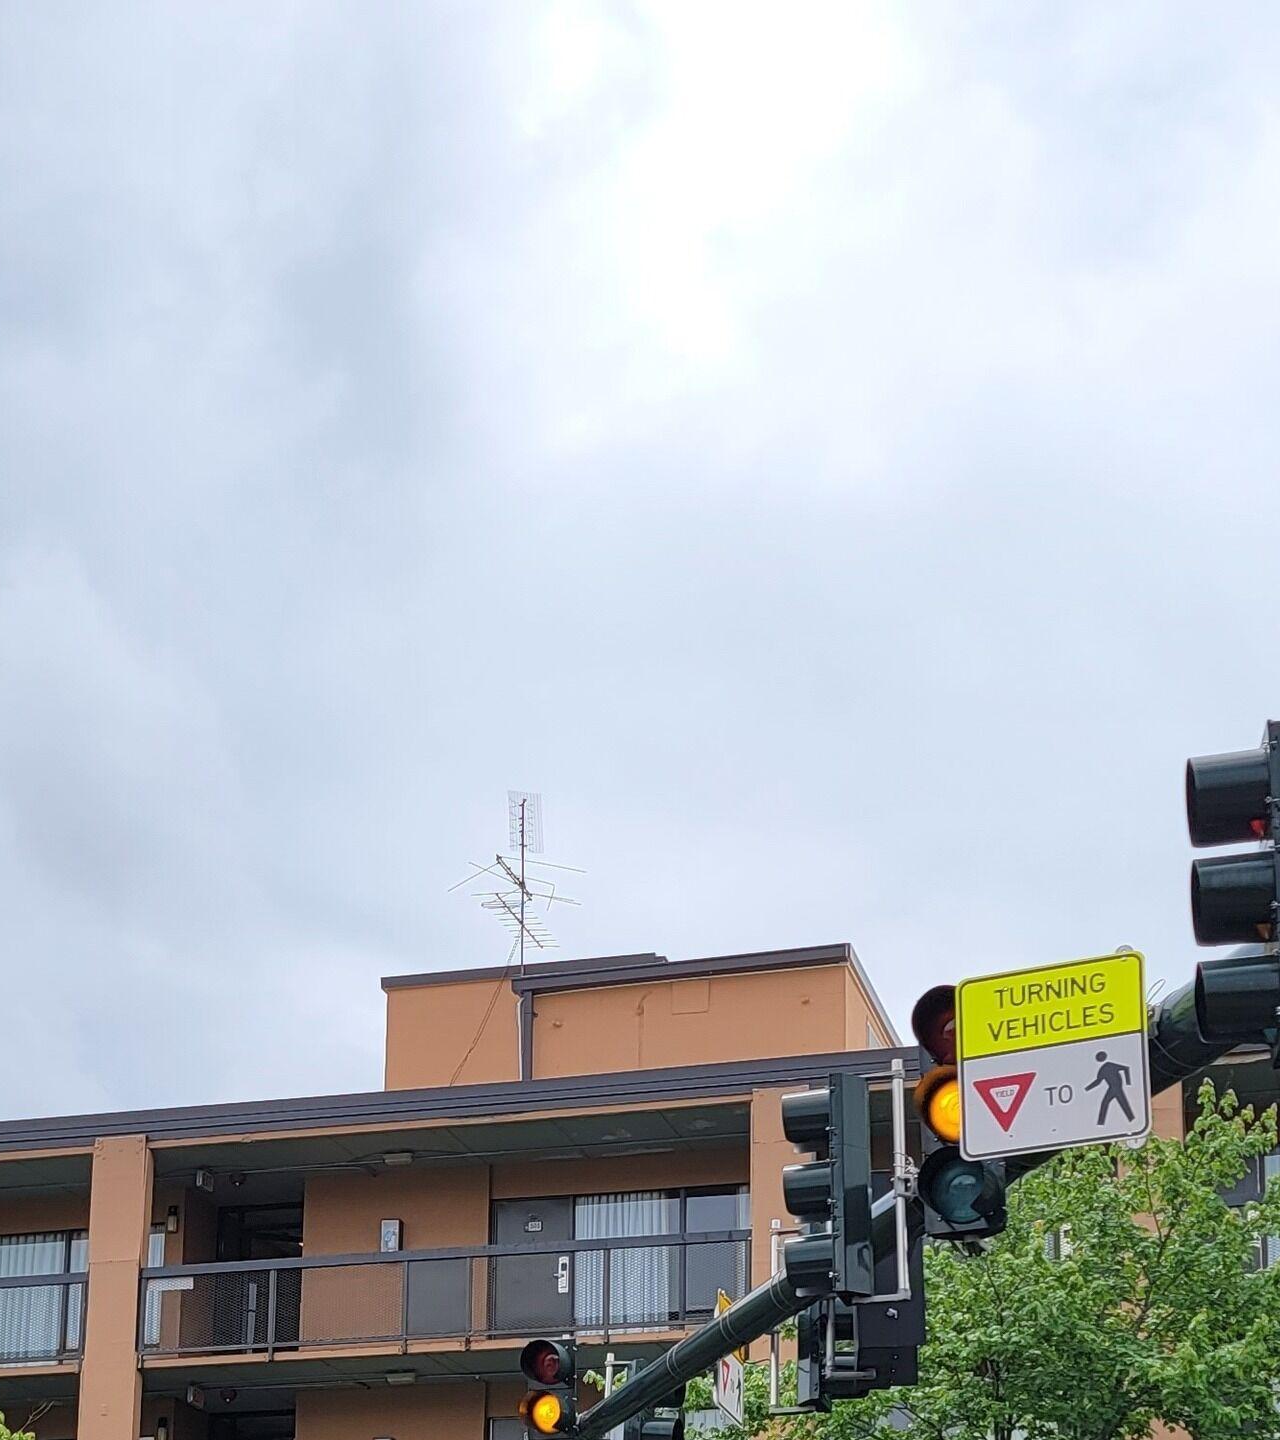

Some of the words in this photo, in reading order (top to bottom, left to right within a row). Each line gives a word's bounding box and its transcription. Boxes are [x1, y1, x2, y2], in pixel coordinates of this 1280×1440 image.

[993, 972, 1106, 1009] TURNING
[987, 1002, 1115, 1042] VEHICLES
[1043, 1084, 1073, 1106] TO
